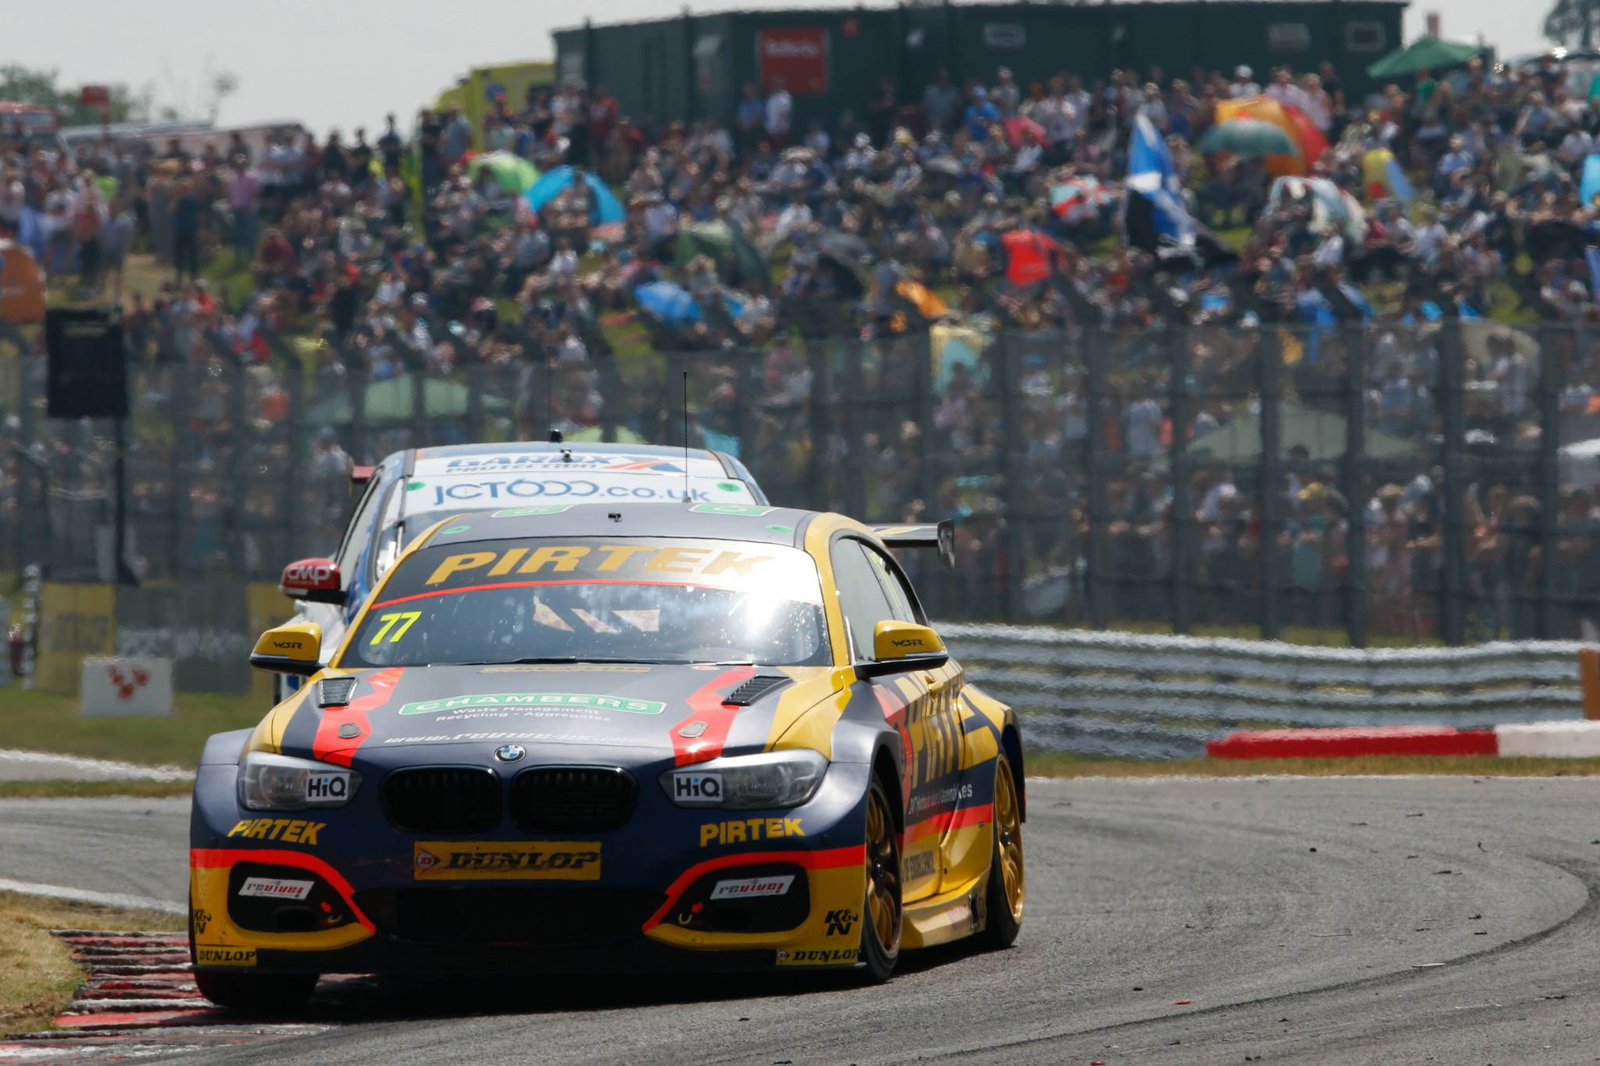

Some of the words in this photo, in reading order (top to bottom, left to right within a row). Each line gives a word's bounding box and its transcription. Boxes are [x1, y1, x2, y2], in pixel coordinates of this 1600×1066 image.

[433, 478, 712, 506] JCT600.co.uk
[425, 545, 777, 586] PIRTEK
[369, 611, 422, 646] 77
[273, 640, 302, 649] WSR
[891, 638, 925, 647] WSR
[416, 694, 649, 712] CHAMBERS
[452, 706, 498, 715] Waste
[503, 706, 599, 715] Management
[436, 712, 508, 721] Recycling
[523, 711, 611, 722] Aggregates
[307, 776, 347, 798] HiQ
[676, 777, 722, 798] HiQ
[227, 818, 327, 846] PIRTEK
[700, 817, 806, 848] PIRTEK
[448, 851, 600, 870] DUNLOP
[199, 950, 257, 962] DUNLOP
